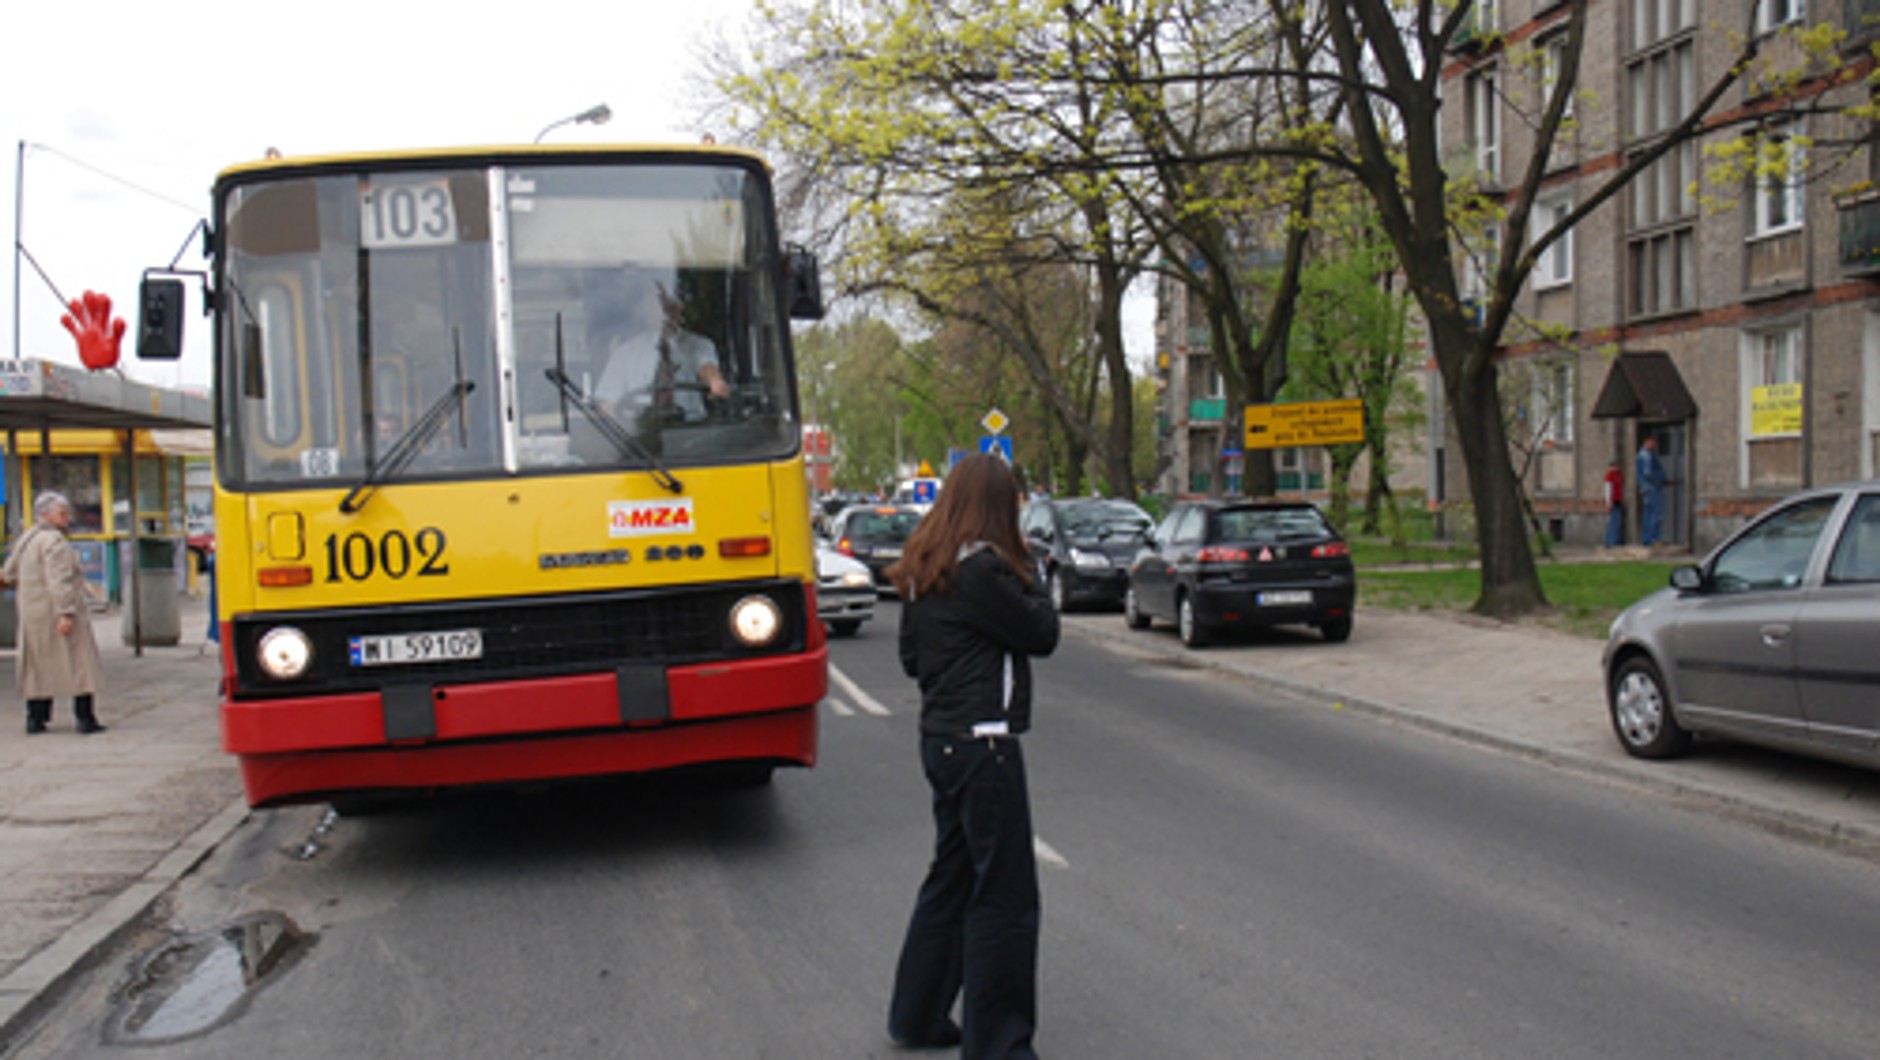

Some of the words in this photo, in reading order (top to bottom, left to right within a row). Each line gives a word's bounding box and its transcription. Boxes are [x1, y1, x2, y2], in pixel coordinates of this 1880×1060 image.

[370, 186, 451, 242] 103
[631, 506, 690, 528] MZA
[323, 525, 450, 584] 1002
[405, 630, 479, 660] 59109
